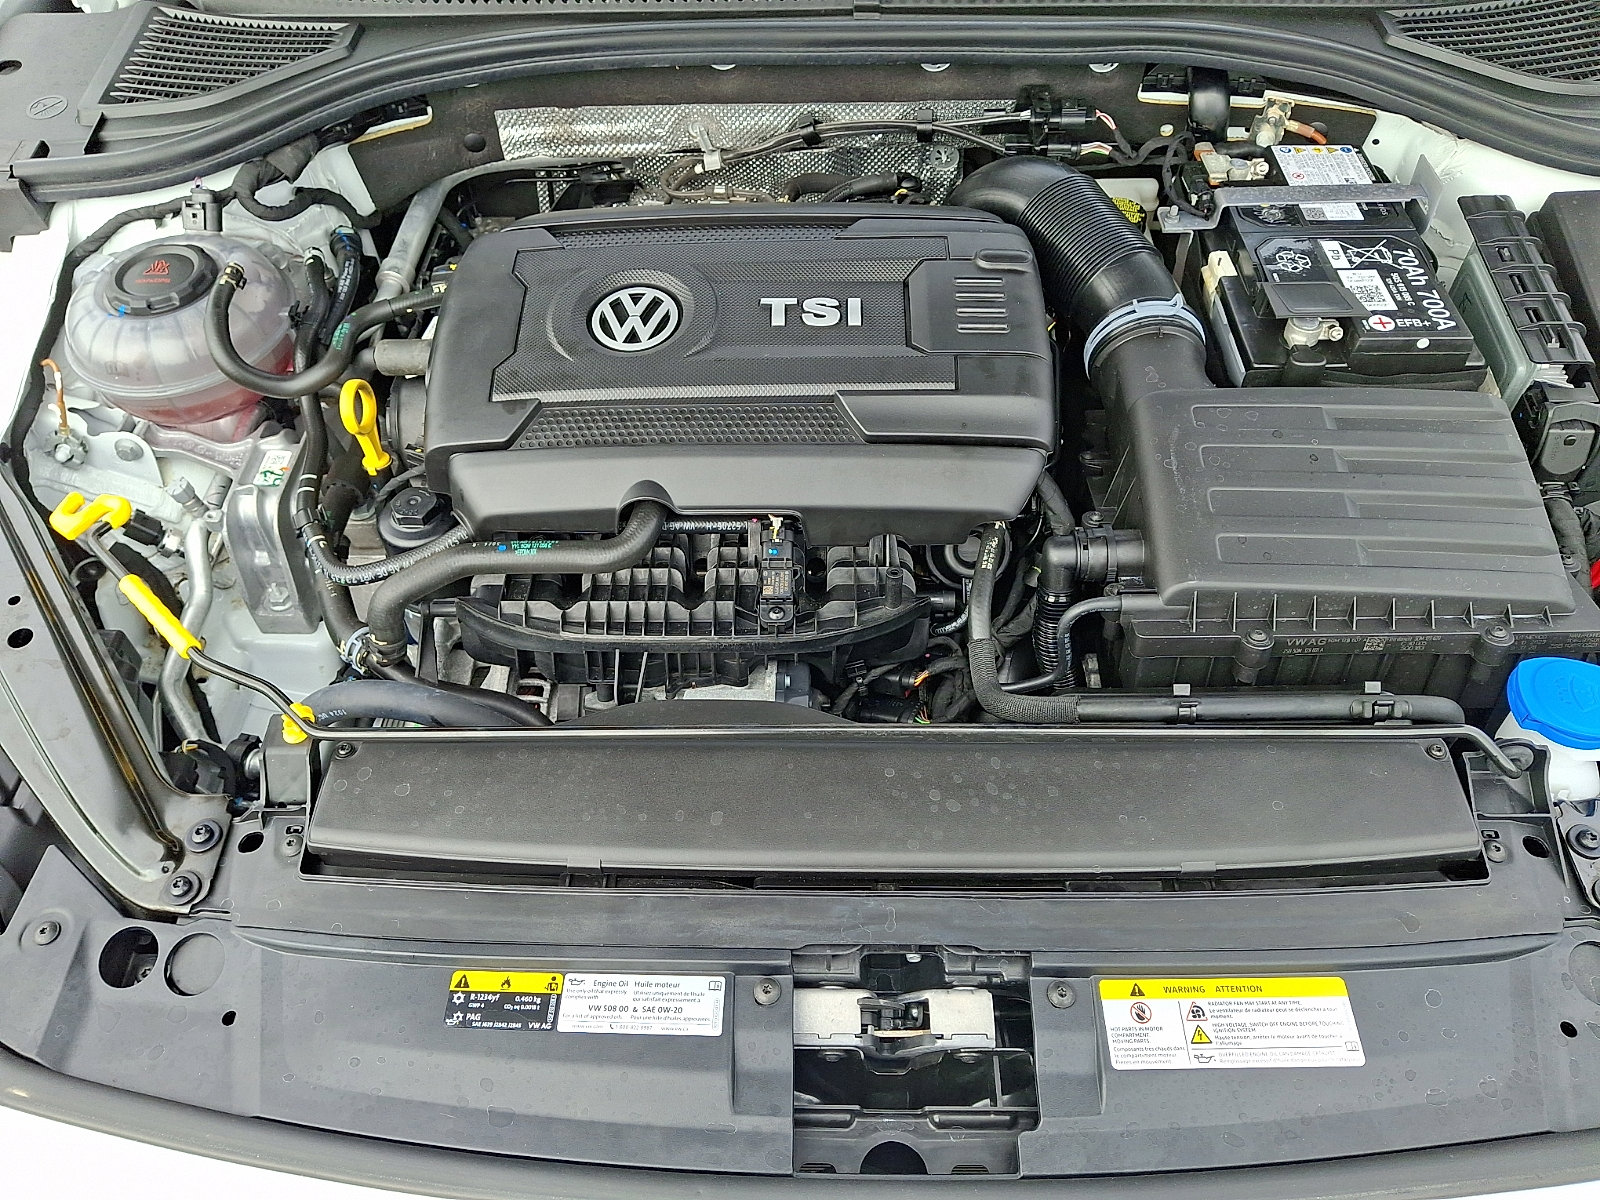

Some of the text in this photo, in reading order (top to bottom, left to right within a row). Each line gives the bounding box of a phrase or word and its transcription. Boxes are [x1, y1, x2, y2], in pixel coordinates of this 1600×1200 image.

[1328, 249, 1341, 260] Pb
[1392, 248, 1457, 331] 70Ah 700A
[760, 297, 862, 326] TSI
[1395, 318, 1432, 328] EFB+
[376, 567, 388, 577] DE
[388, 564, 400, 574] AG
[593, 980, 617, 988] Engine
[470, 993, 500, 1004] R-1234yf
